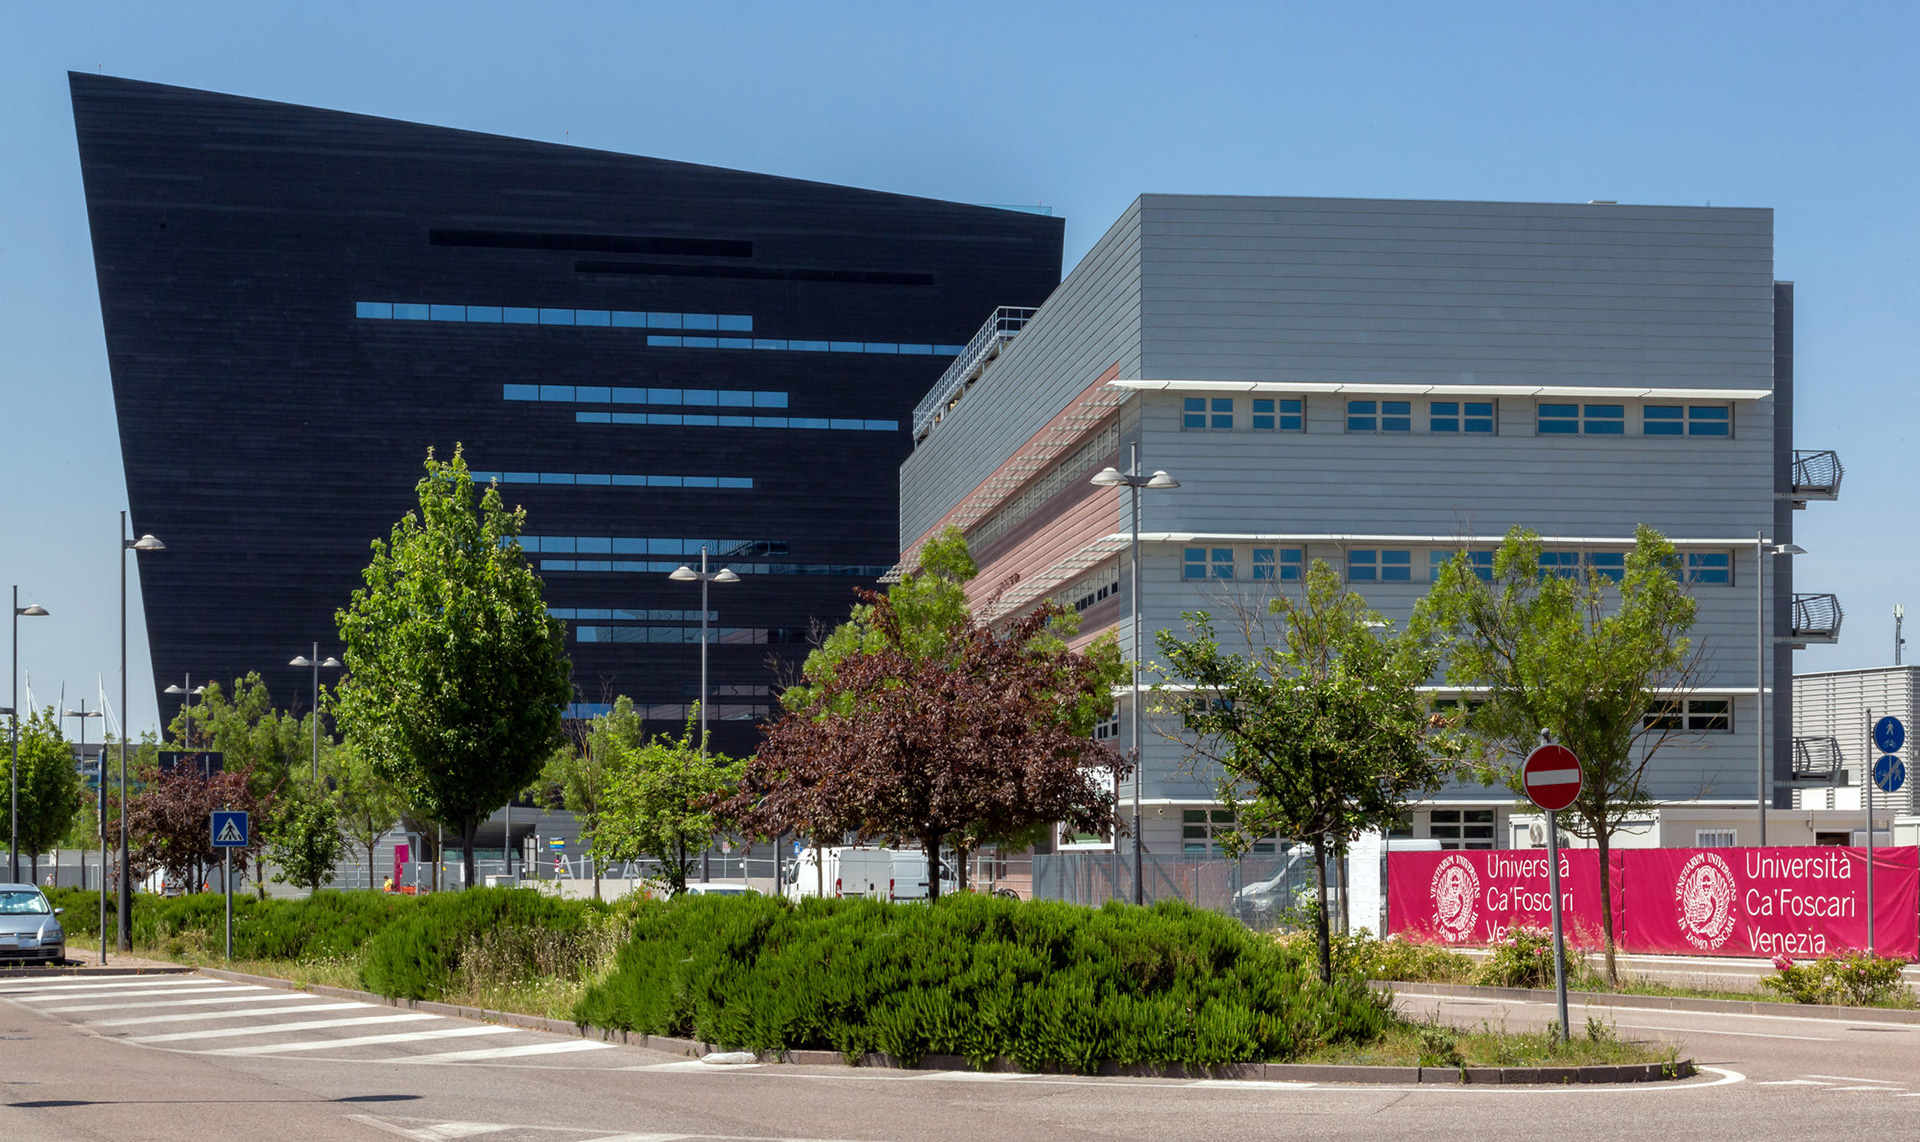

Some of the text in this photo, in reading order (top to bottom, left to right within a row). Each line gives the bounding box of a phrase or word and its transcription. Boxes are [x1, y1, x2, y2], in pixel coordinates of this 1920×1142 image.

[1487, 853, 1570, 878] Universà
[1746, 851, 1851, 879] Università
[1487, 886, 1573, 912] Ca'Foscri
[1746, 888, 1855, 917] Ca'Foscari
[1747, 925, 1826, 954] Venezia
